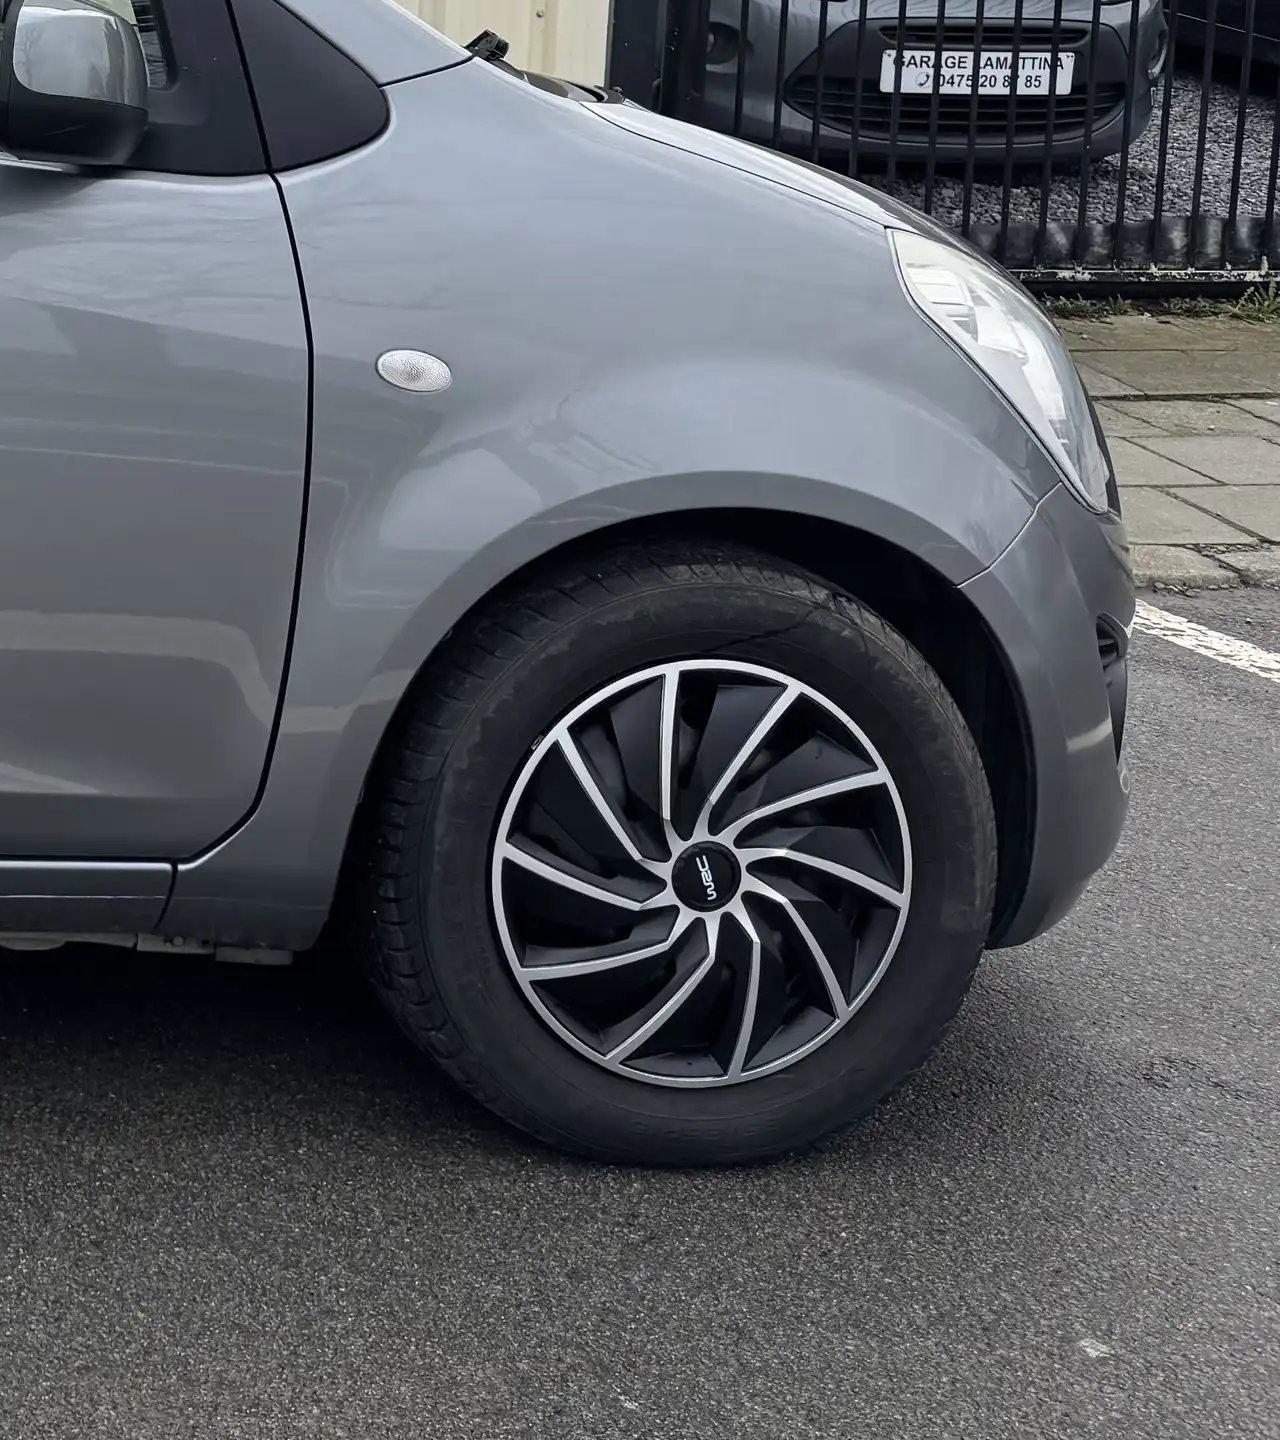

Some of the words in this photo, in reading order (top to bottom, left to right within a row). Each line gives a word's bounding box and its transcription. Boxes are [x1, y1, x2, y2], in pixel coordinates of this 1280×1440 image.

[975, 56, 1064, 70] AMTTINA
[1002, 74, 1020, 88] 8
[1024, 74, 1042, 89] 85
